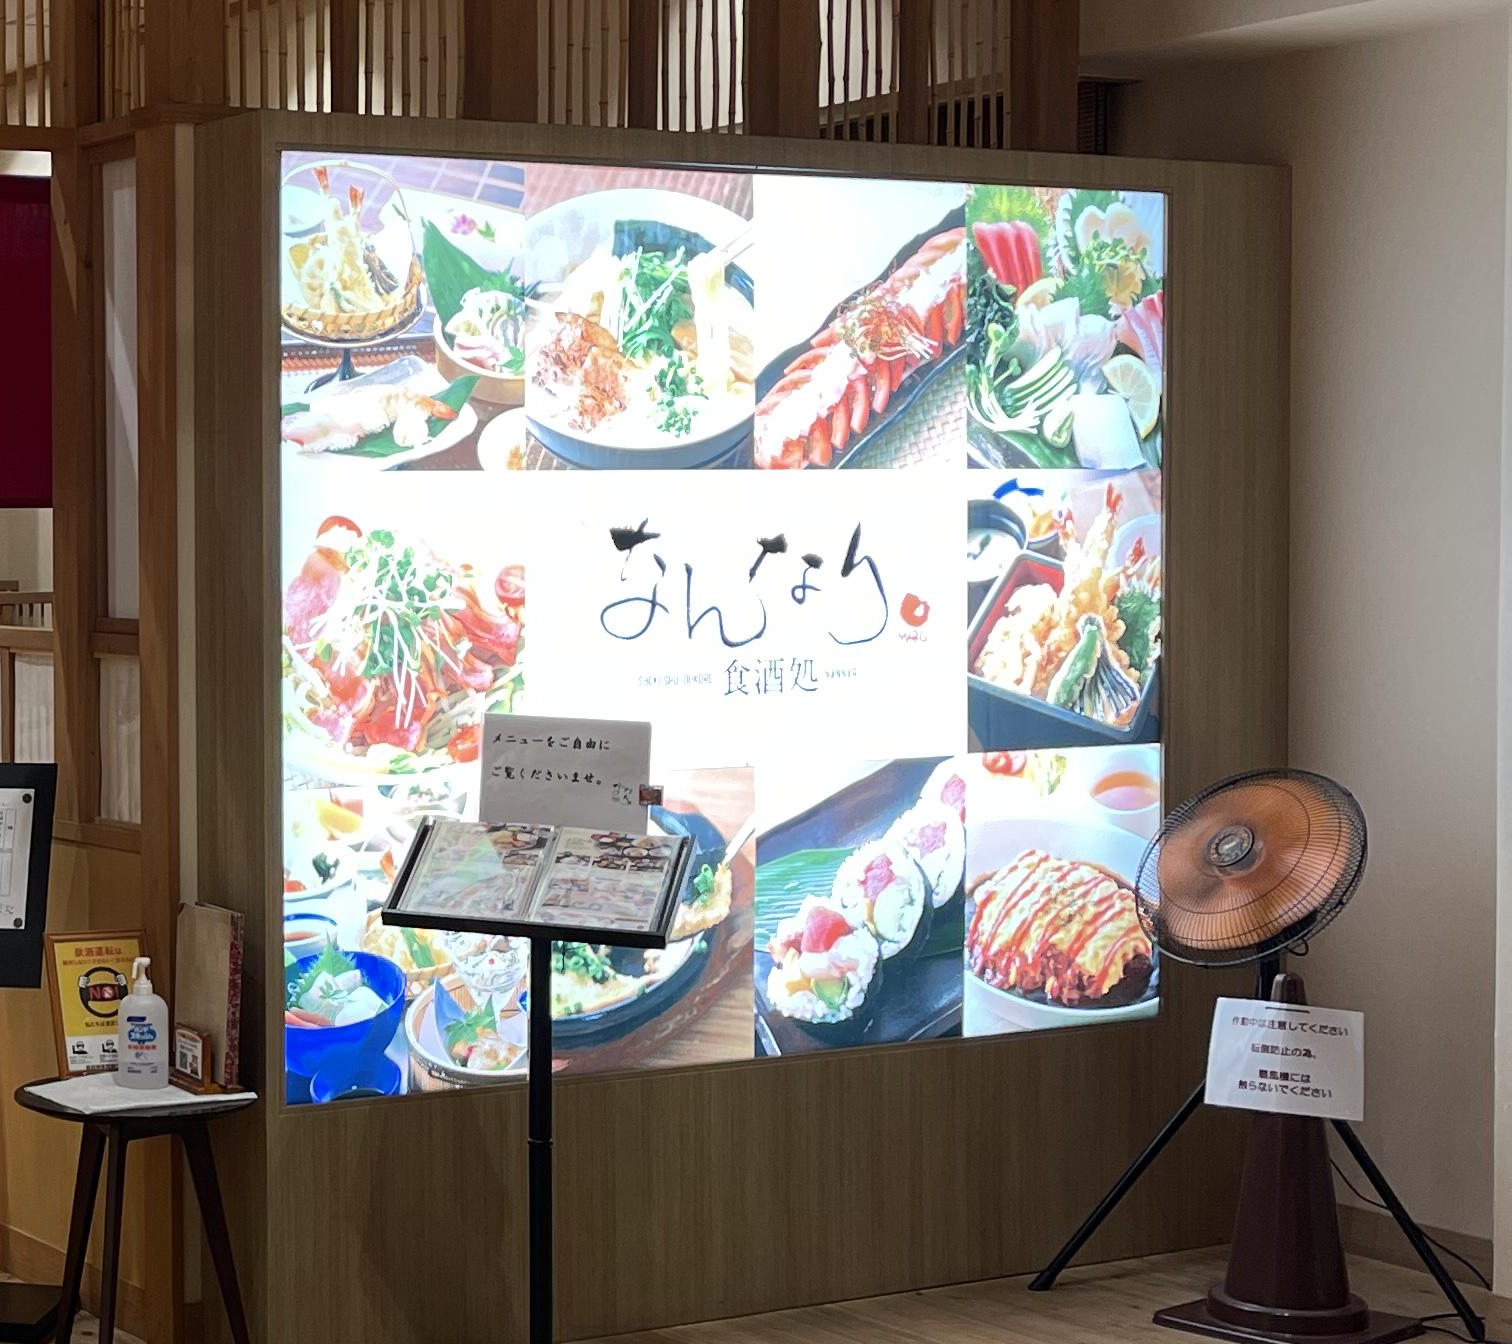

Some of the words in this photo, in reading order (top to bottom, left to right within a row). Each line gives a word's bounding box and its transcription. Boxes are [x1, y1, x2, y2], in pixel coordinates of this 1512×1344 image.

[723, 657, 820, 697] 食酒処
[492, 732, 610, 751] メニューをご自由に
[491, 765, 602, 786] ご覧くださいませ。
[1238, 1079, 1333, 1099] 触らないでください
